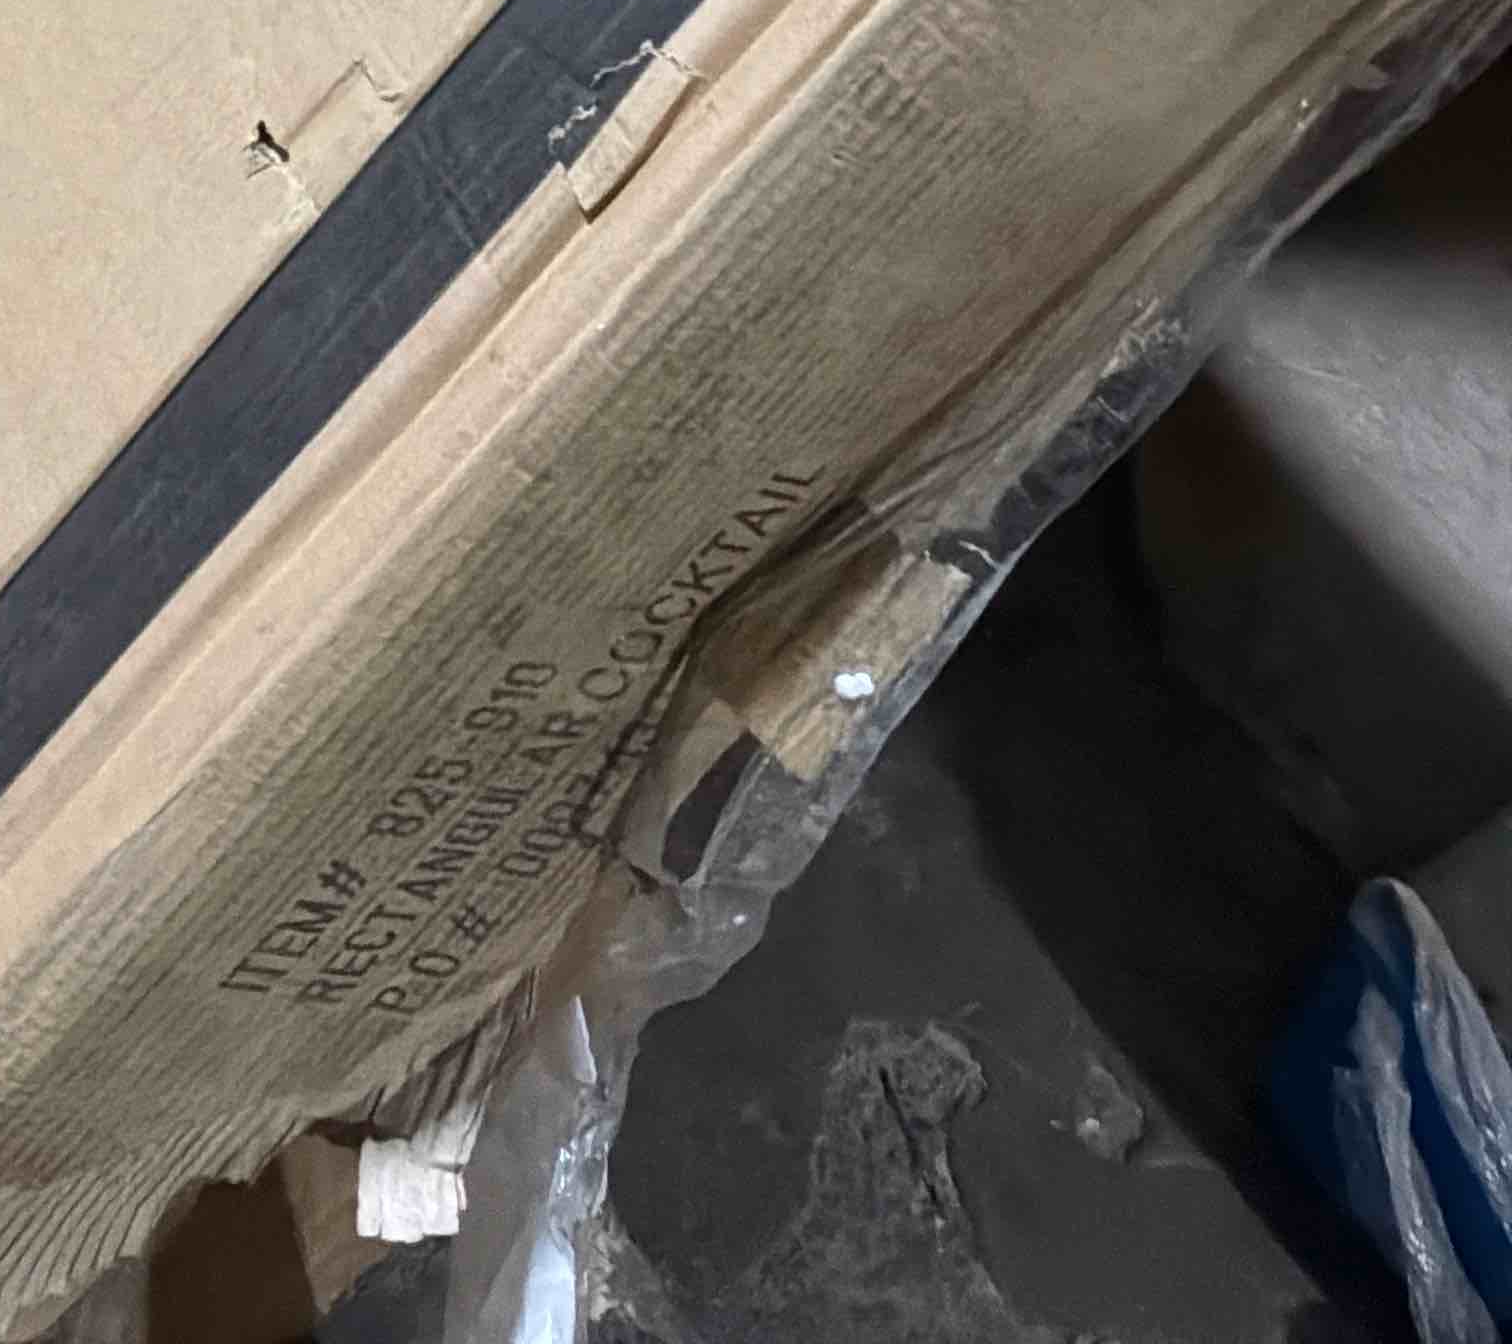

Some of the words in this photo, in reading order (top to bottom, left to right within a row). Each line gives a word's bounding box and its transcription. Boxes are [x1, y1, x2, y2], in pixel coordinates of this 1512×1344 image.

[218, 859, 367, 993] ITEM#
[365, 661, 558, 838] 825-910
[292, 711, 598, 1004] RECTANGULAR
[578, 465, 826, 702] COCKTAIL
